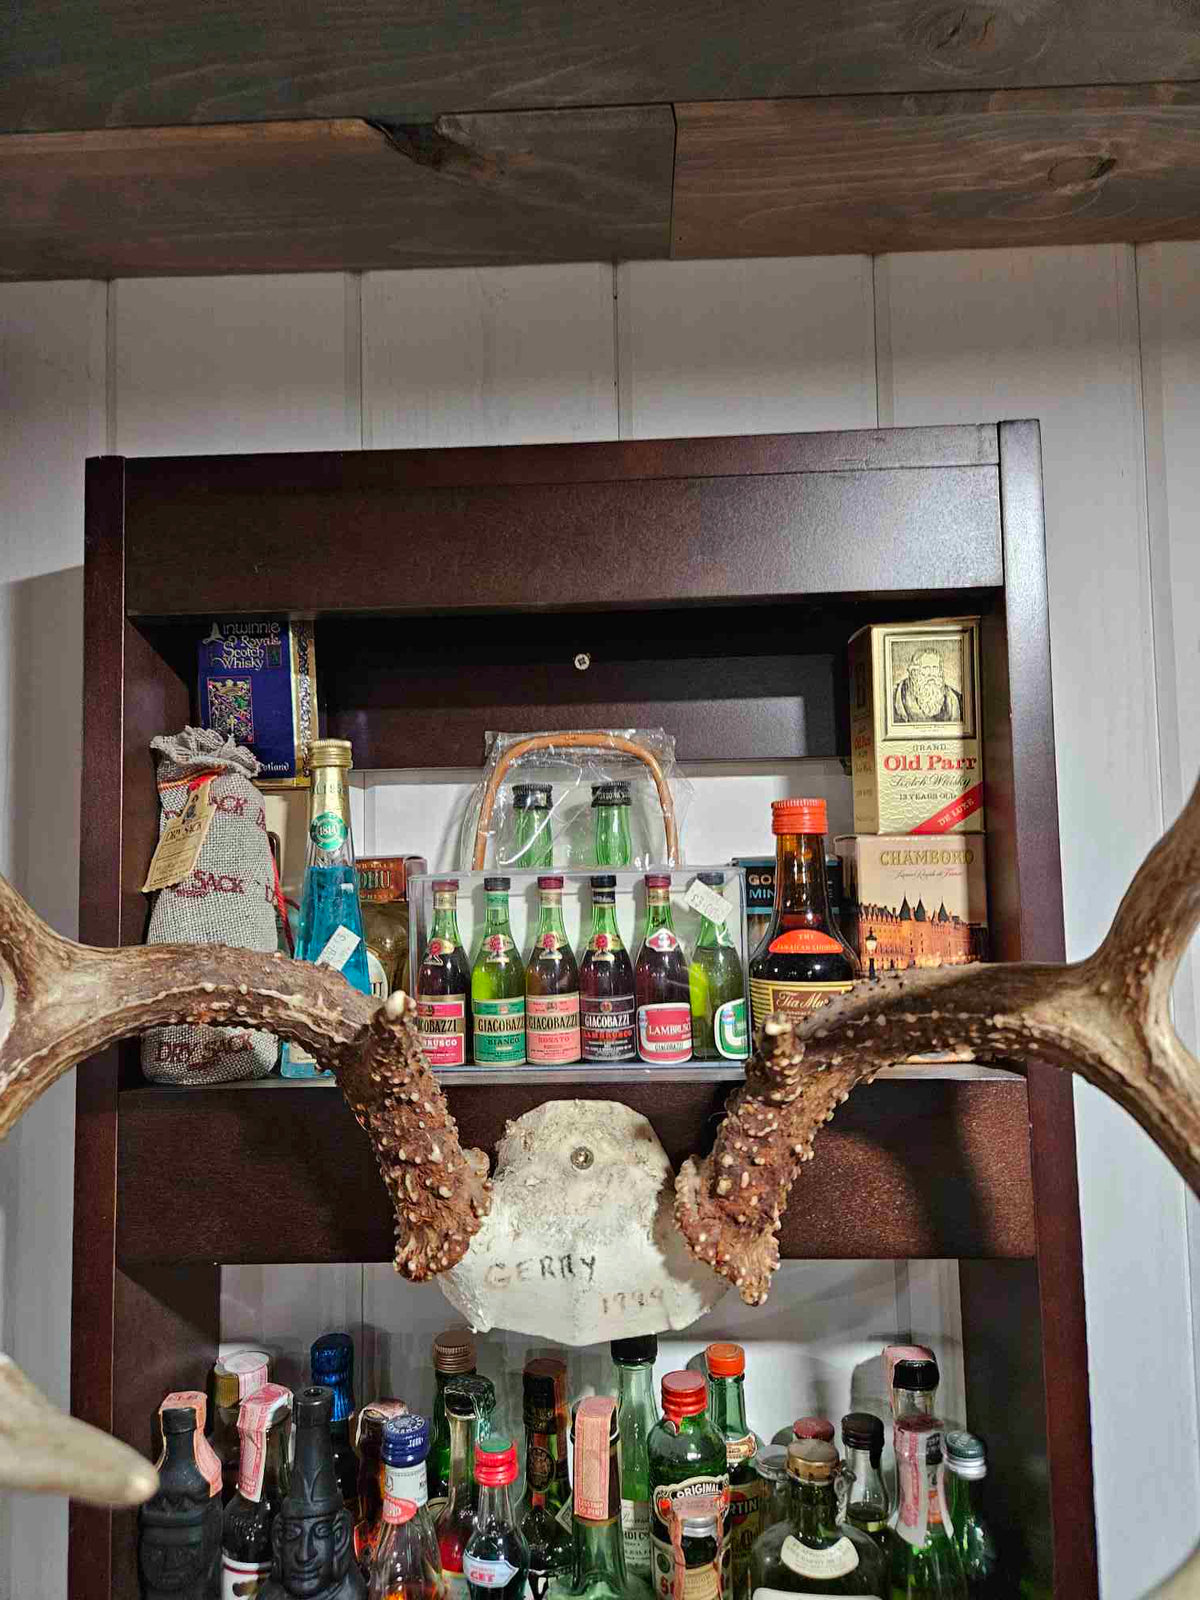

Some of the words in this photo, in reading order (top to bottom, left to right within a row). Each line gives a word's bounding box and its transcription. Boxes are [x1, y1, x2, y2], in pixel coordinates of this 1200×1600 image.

[222, 640, 265, 658] Scotch
[211, 657, 265, 672] Whisky
[912, 743, 947, 752] GRAND
[883, 753, 922, 771] Old
[926, 754, 978, 771] Parr
[928, 773, 972, 789] Whisky
[909, 793, 938, 801] YEARS
[939, 792, 957, 800] OLD
[937, 812, 953, 826] DE
[951, 798, 976, 817] LUXE
[880, 848, 975, 866] CHAMBORD
[528, 1013, 577, 1031] GIACOBAZZI
[583, 1014, 630, 1029] GIACOBAZZI
[486, 1037, 520, 1046] BIANCO
[537, 1036, 570, 1045] ROSATO
[584, 1028, 633, 1040] LAMBRUSCO
[483, 1253, 597, 1290] GERRY
[676, 1483, 721, 1499] ORIGINAL
